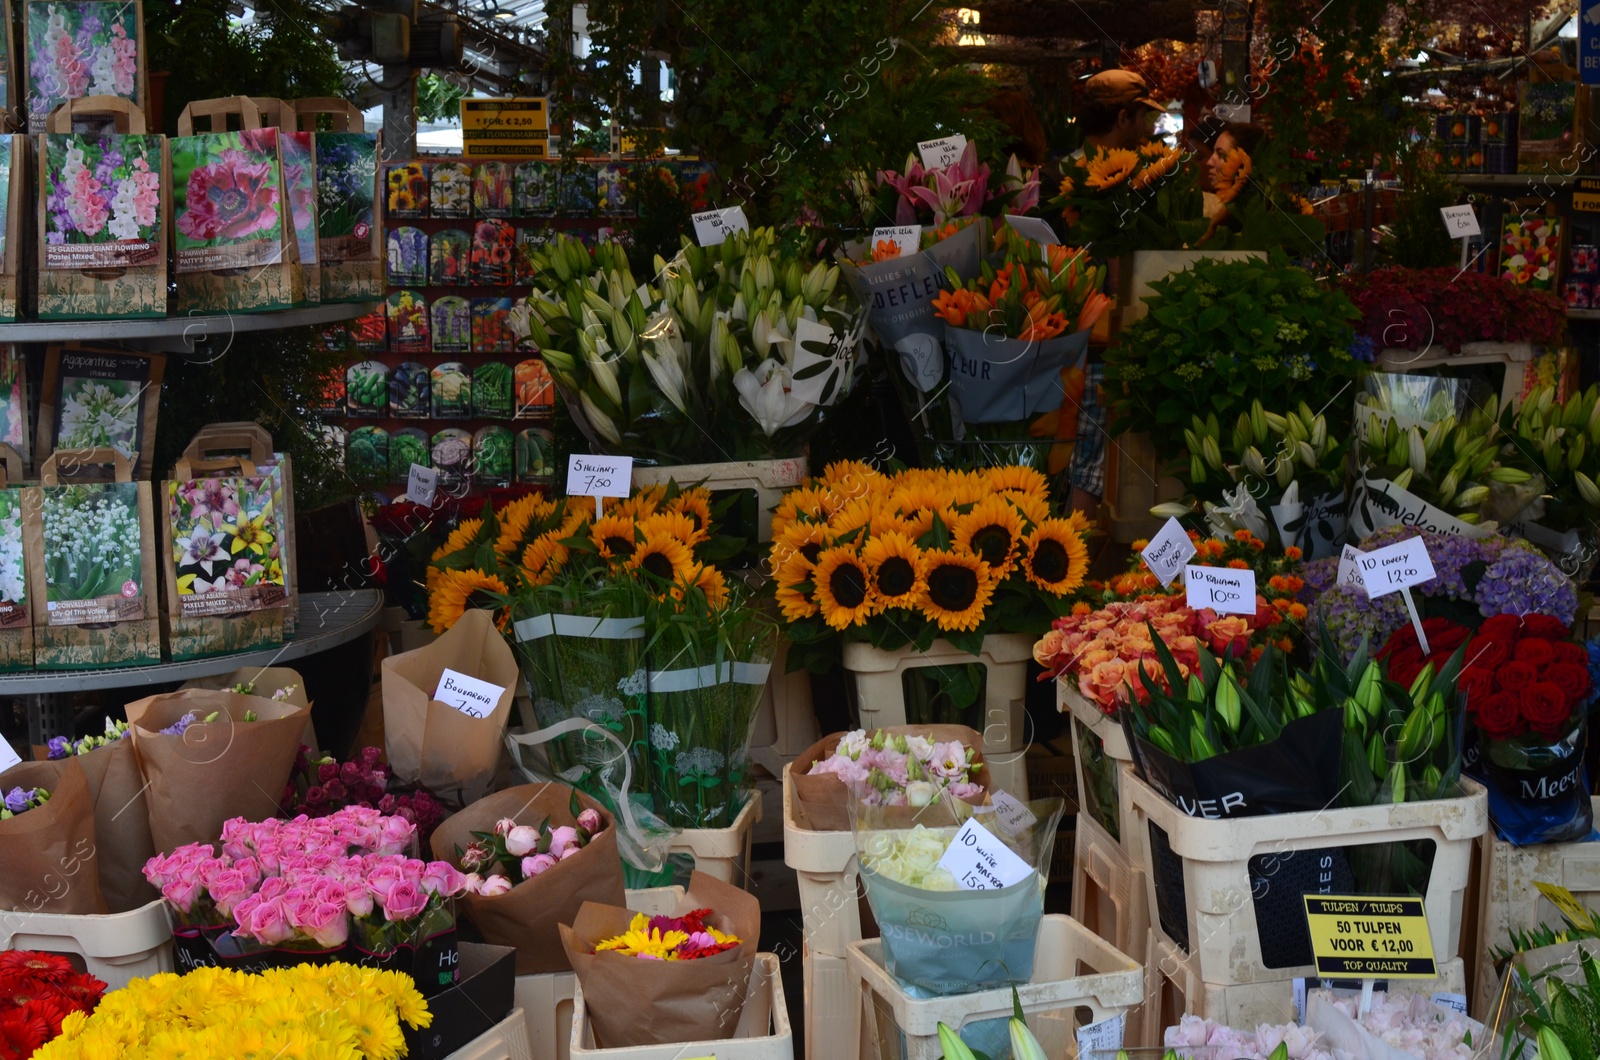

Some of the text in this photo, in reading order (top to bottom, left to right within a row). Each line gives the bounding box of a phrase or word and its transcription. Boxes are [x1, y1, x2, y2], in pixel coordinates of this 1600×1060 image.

[514, 118, 532, 126] 2,50
[497, 146, 542, 154] COLLECTION
[868, 266, 917, 285] LILIES BY
[63, 354, 117, 369] Agapanthus
[573, 459, 583, 472] 5
[1361, 558, 1376, 571] 10
[1191, 570, 1203, 580] 10
[183, 599, 227, 609] PIXELS MIXED
[960, 828, 977, 846] 10
[1321, 901, 1403, 913] TULPEN / TULIPS
[1336, 920, 1402, 934] 50 TULPEN
[1330, 938, 1413, 955] VOOR € 12,00
[1343, 961, 1408, 971] TOP QUALITY
